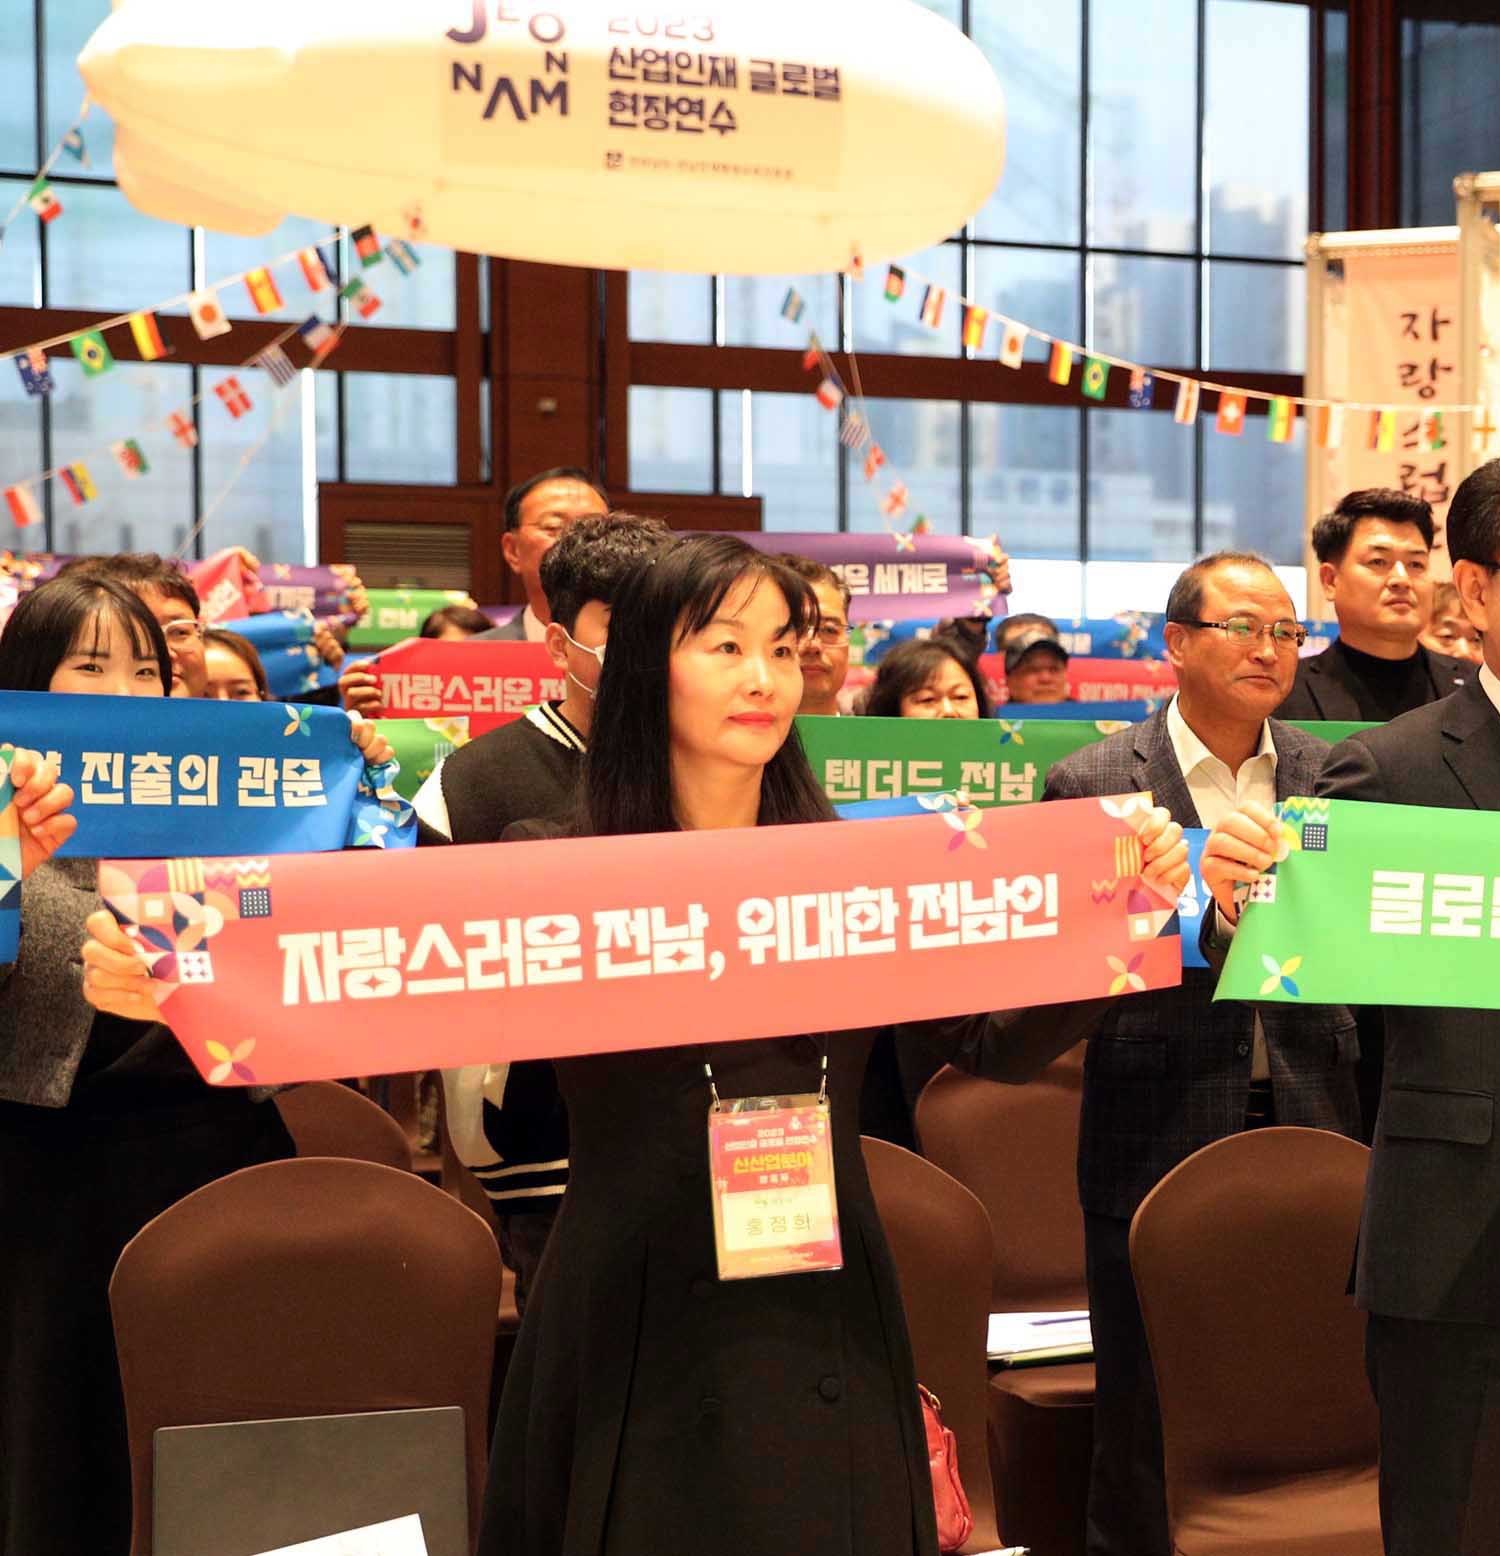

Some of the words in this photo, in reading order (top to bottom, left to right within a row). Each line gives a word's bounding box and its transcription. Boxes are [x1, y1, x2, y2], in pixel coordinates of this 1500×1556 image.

[608, 47, 738, 88] 산업인재
[749, 59, 841, 101] 글로벌
[608, 90, 738, 136] 현장연수
[873, 563, 949, 596] 세계로
[380, 673, 533, 714] 자랑스러운
[81, 752, 219, 807] 진출의
[238, 756, 329, 808] 관문
[960, 761, 1038, 802] 전남
[278, 913, 584, 1007] 자랑스러운
[593, 904, 725, 981] 전남,
[736, 887, 899, 967] 위대한
[907, 873, 1059, 951] 전남인
